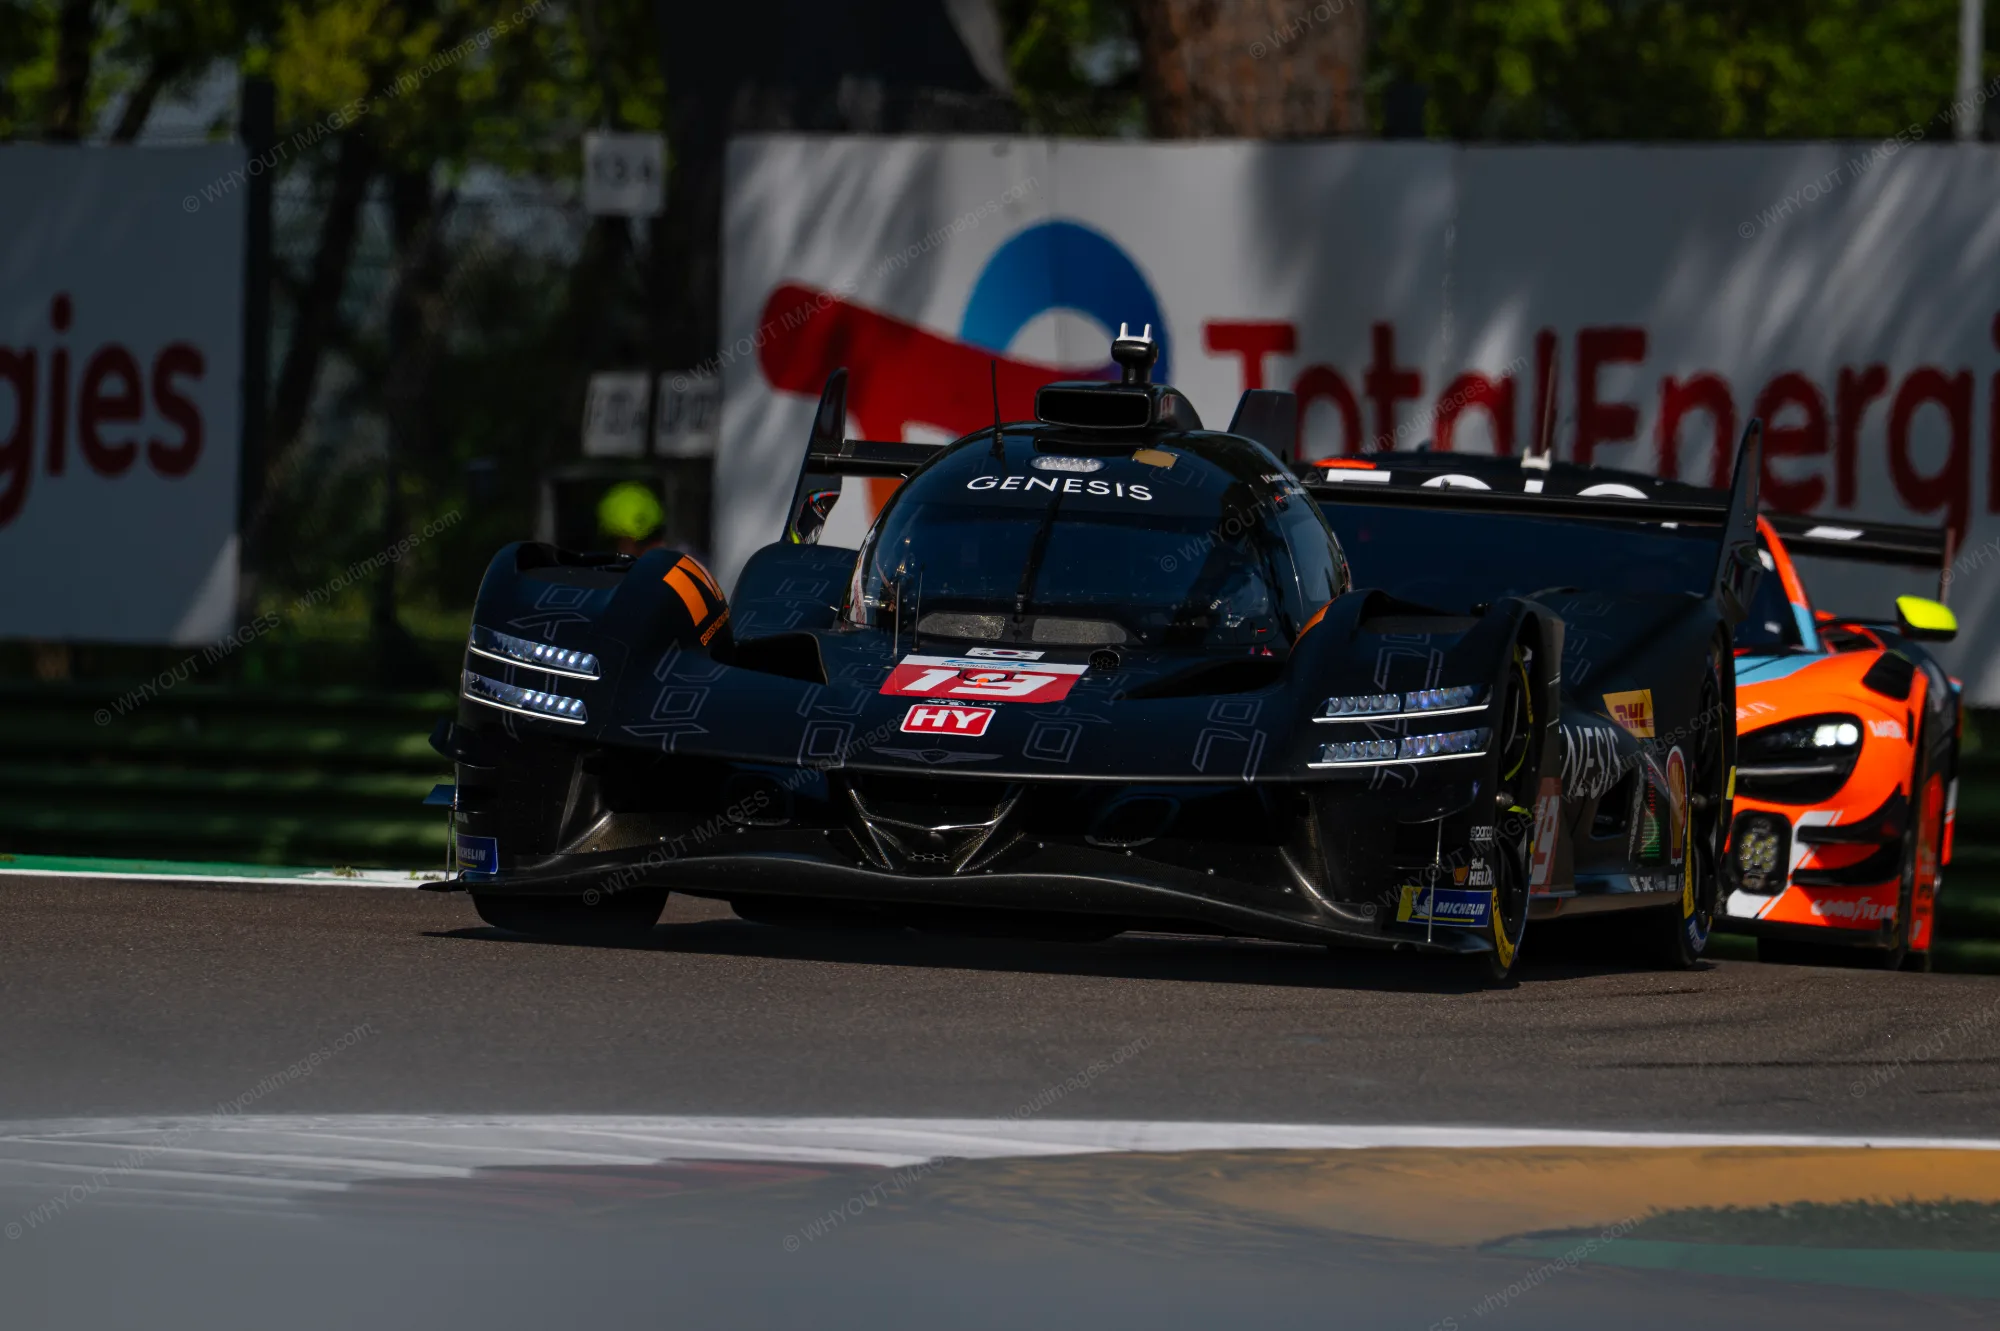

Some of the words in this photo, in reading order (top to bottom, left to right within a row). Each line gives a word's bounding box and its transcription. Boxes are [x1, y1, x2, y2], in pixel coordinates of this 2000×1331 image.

[966, 475, 1153, 501] GENESIS
[903, 669, 1057, 697] 19
[909, 708, 987, 730] HY
[1558, 724, 1621, 800] NESIS
[1471, 858, 1484, 869] Shell
[1468, 866, 1493, 885] HELIX
[1436, 902, 1486, 915] MICHELIN
